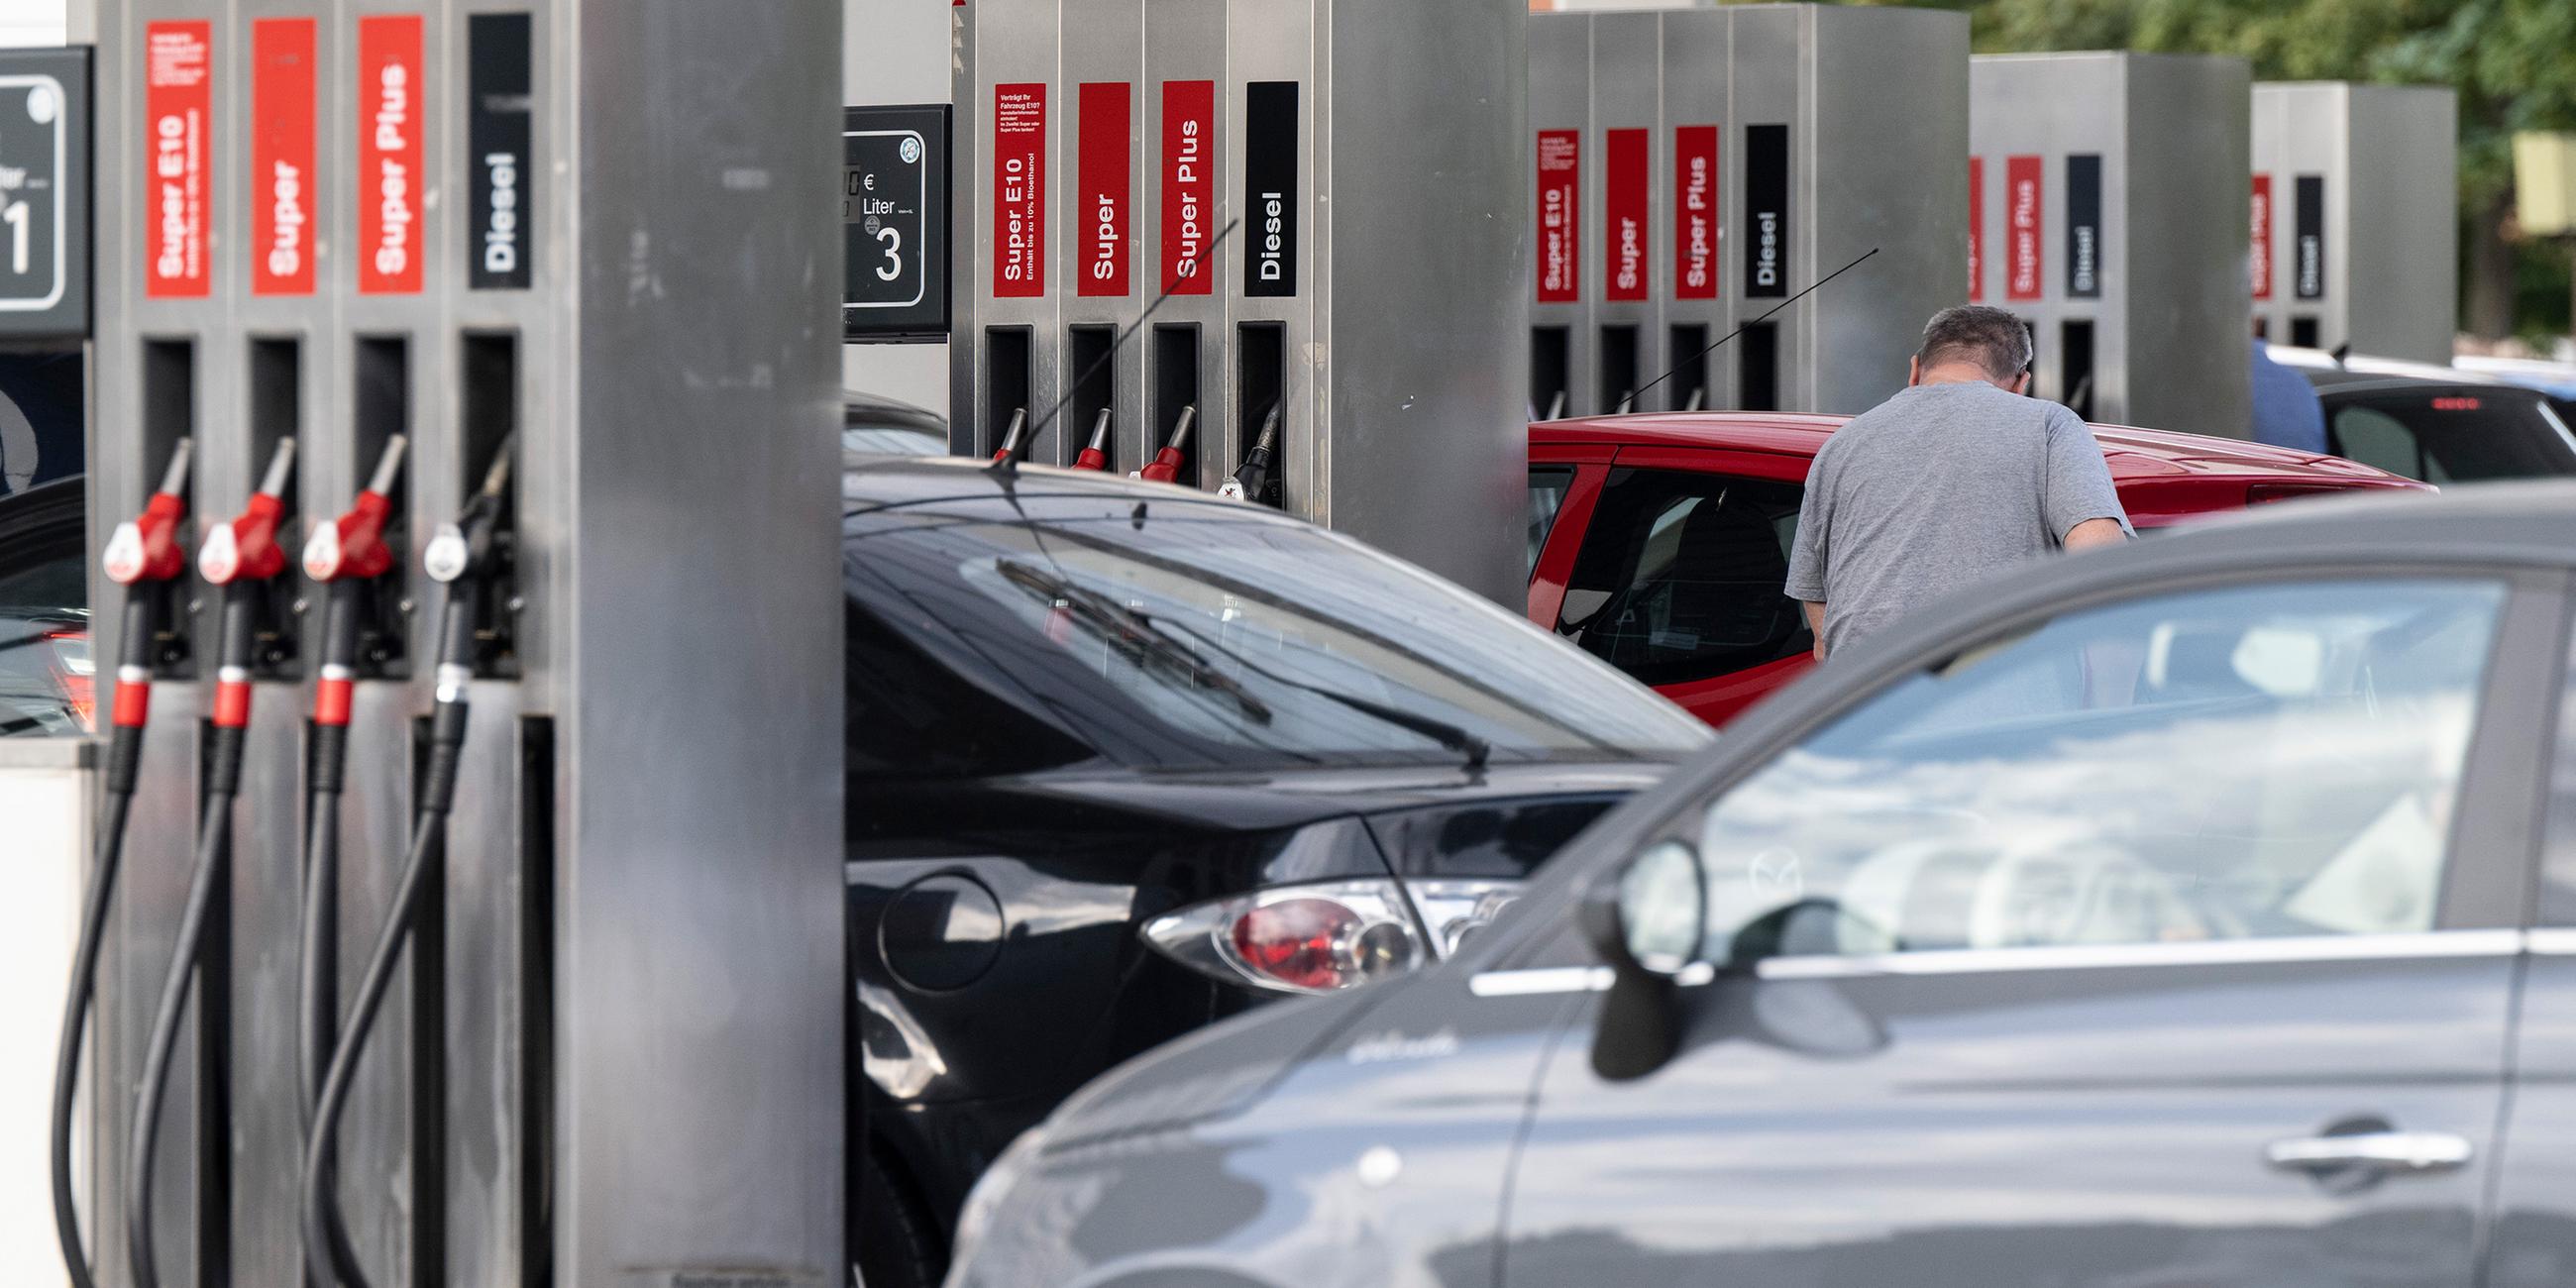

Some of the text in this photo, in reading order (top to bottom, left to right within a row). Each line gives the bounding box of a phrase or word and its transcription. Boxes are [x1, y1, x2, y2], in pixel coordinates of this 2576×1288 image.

[159, 116, 184, 177] E10
[376, 63, 411, 275] Super Plus
[864, 173, 874, 190] €
[158, 183, 186, 278] Super
[268, 161, 304, 276] Super
[485, 153, 516, 272] Diesel
[864, 198, 896, 215] Liter
[1005, 159, 1024, 280] Super E10
[1028, 222, 1033, 232] zu
[1177, 121, 1201, 277] Super Plus
[1261, 192, 1281, 279] Diesel
[1546, 189, 1561, 228] E10
[1687, 156, 1710, 287] Super Plus
[2014, 180, 2036, 292] Super Plus
[4, 200, 29, 273] 1
[876, 227, 902, 281] 3
[1094, 194, 1118, 279] Super
[1546, 232, 1564, 291] Super
[1618, 217, 1641, 289] Super
[1758, 212, 1775, 286] Diesel
[2074, 226, 2093, 291] Diesel
